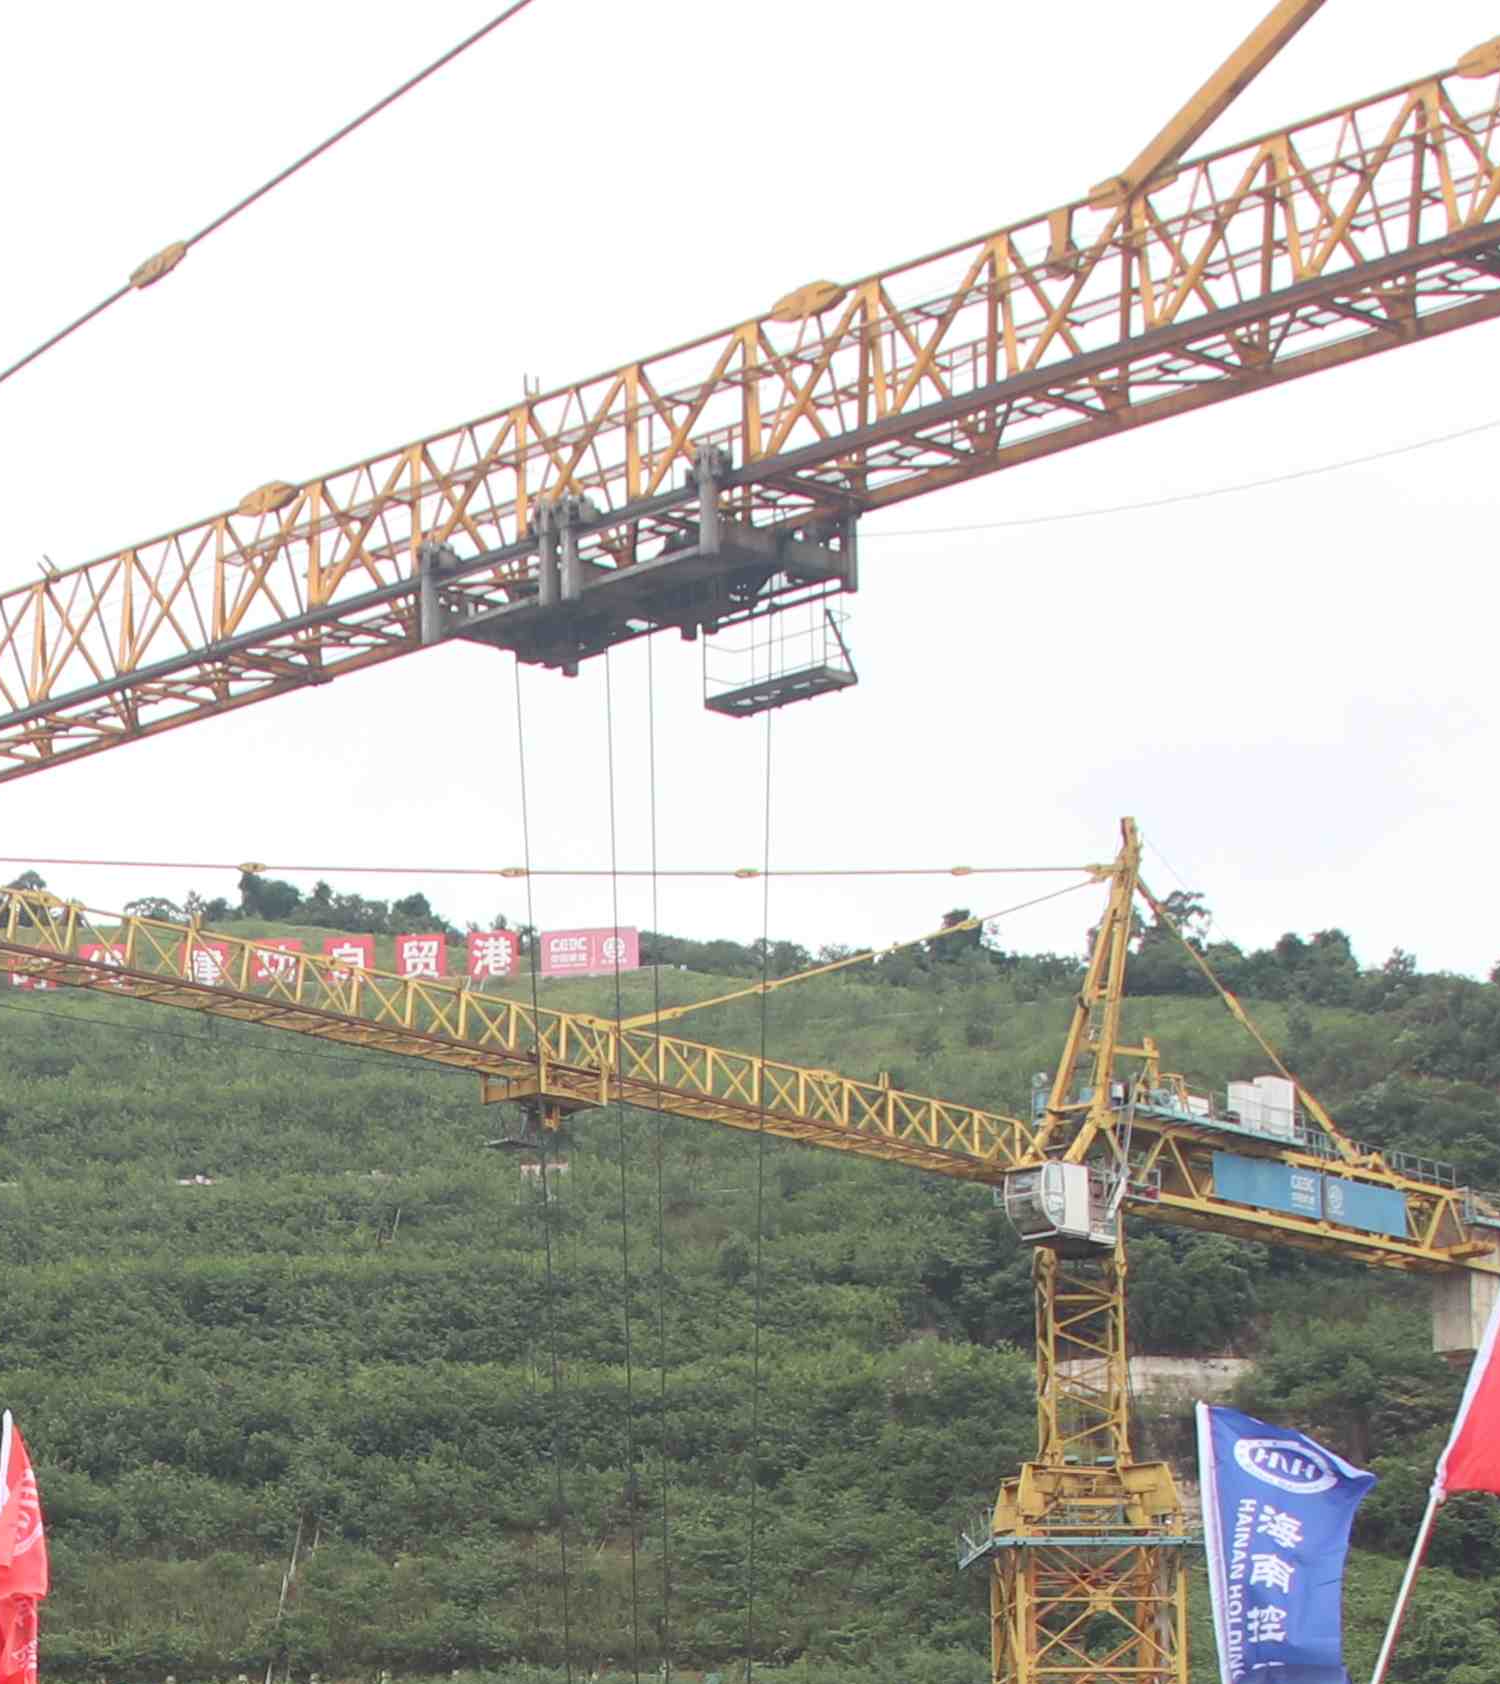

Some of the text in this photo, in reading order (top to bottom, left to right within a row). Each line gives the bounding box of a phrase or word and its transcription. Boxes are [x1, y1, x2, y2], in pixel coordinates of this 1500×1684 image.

[1230, 1499, 1257, 1579] HAINAN
[1247, 1504, 1303, 1670] 海南控
